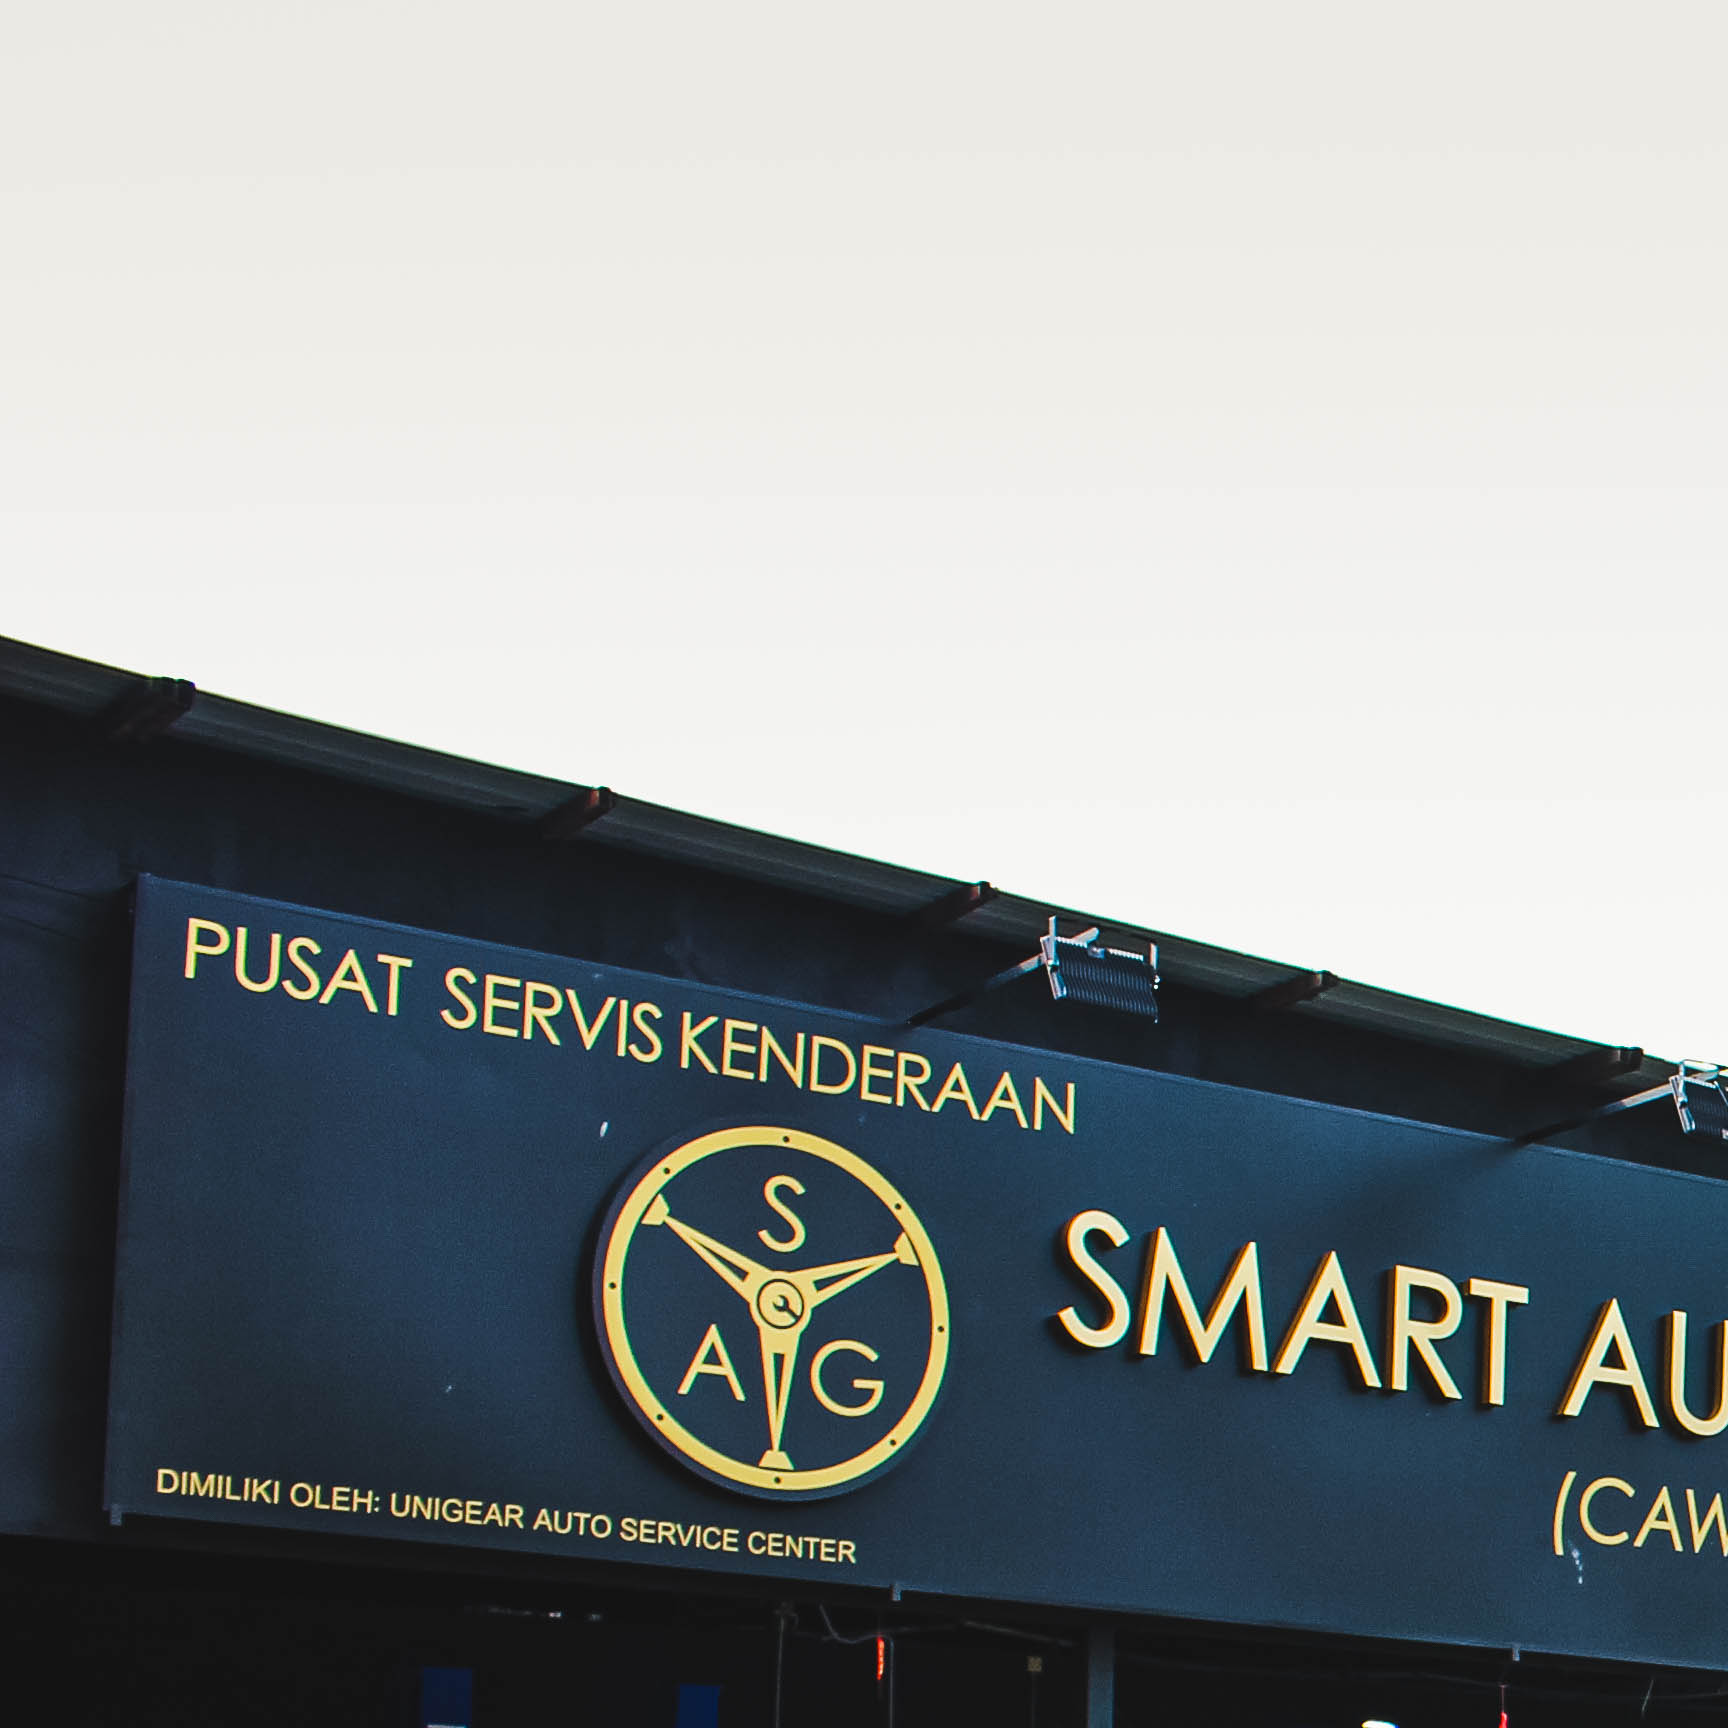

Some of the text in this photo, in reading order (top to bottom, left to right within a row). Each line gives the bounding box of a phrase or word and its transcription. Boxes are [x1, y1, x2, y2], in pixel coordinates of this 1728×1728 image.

[184, 917, 1076, 1134] PUSAT SERVIS KENDERAAN
[757, 1174, 805, 1254] S
[1057, 1209, 1530, 1406] SMART
[677, 1323, 885, 1418] A G
[155, 1467, 856, 1565] DIMILIKI OLEH: UNIGEAR AUTO SERVICE CENTER
